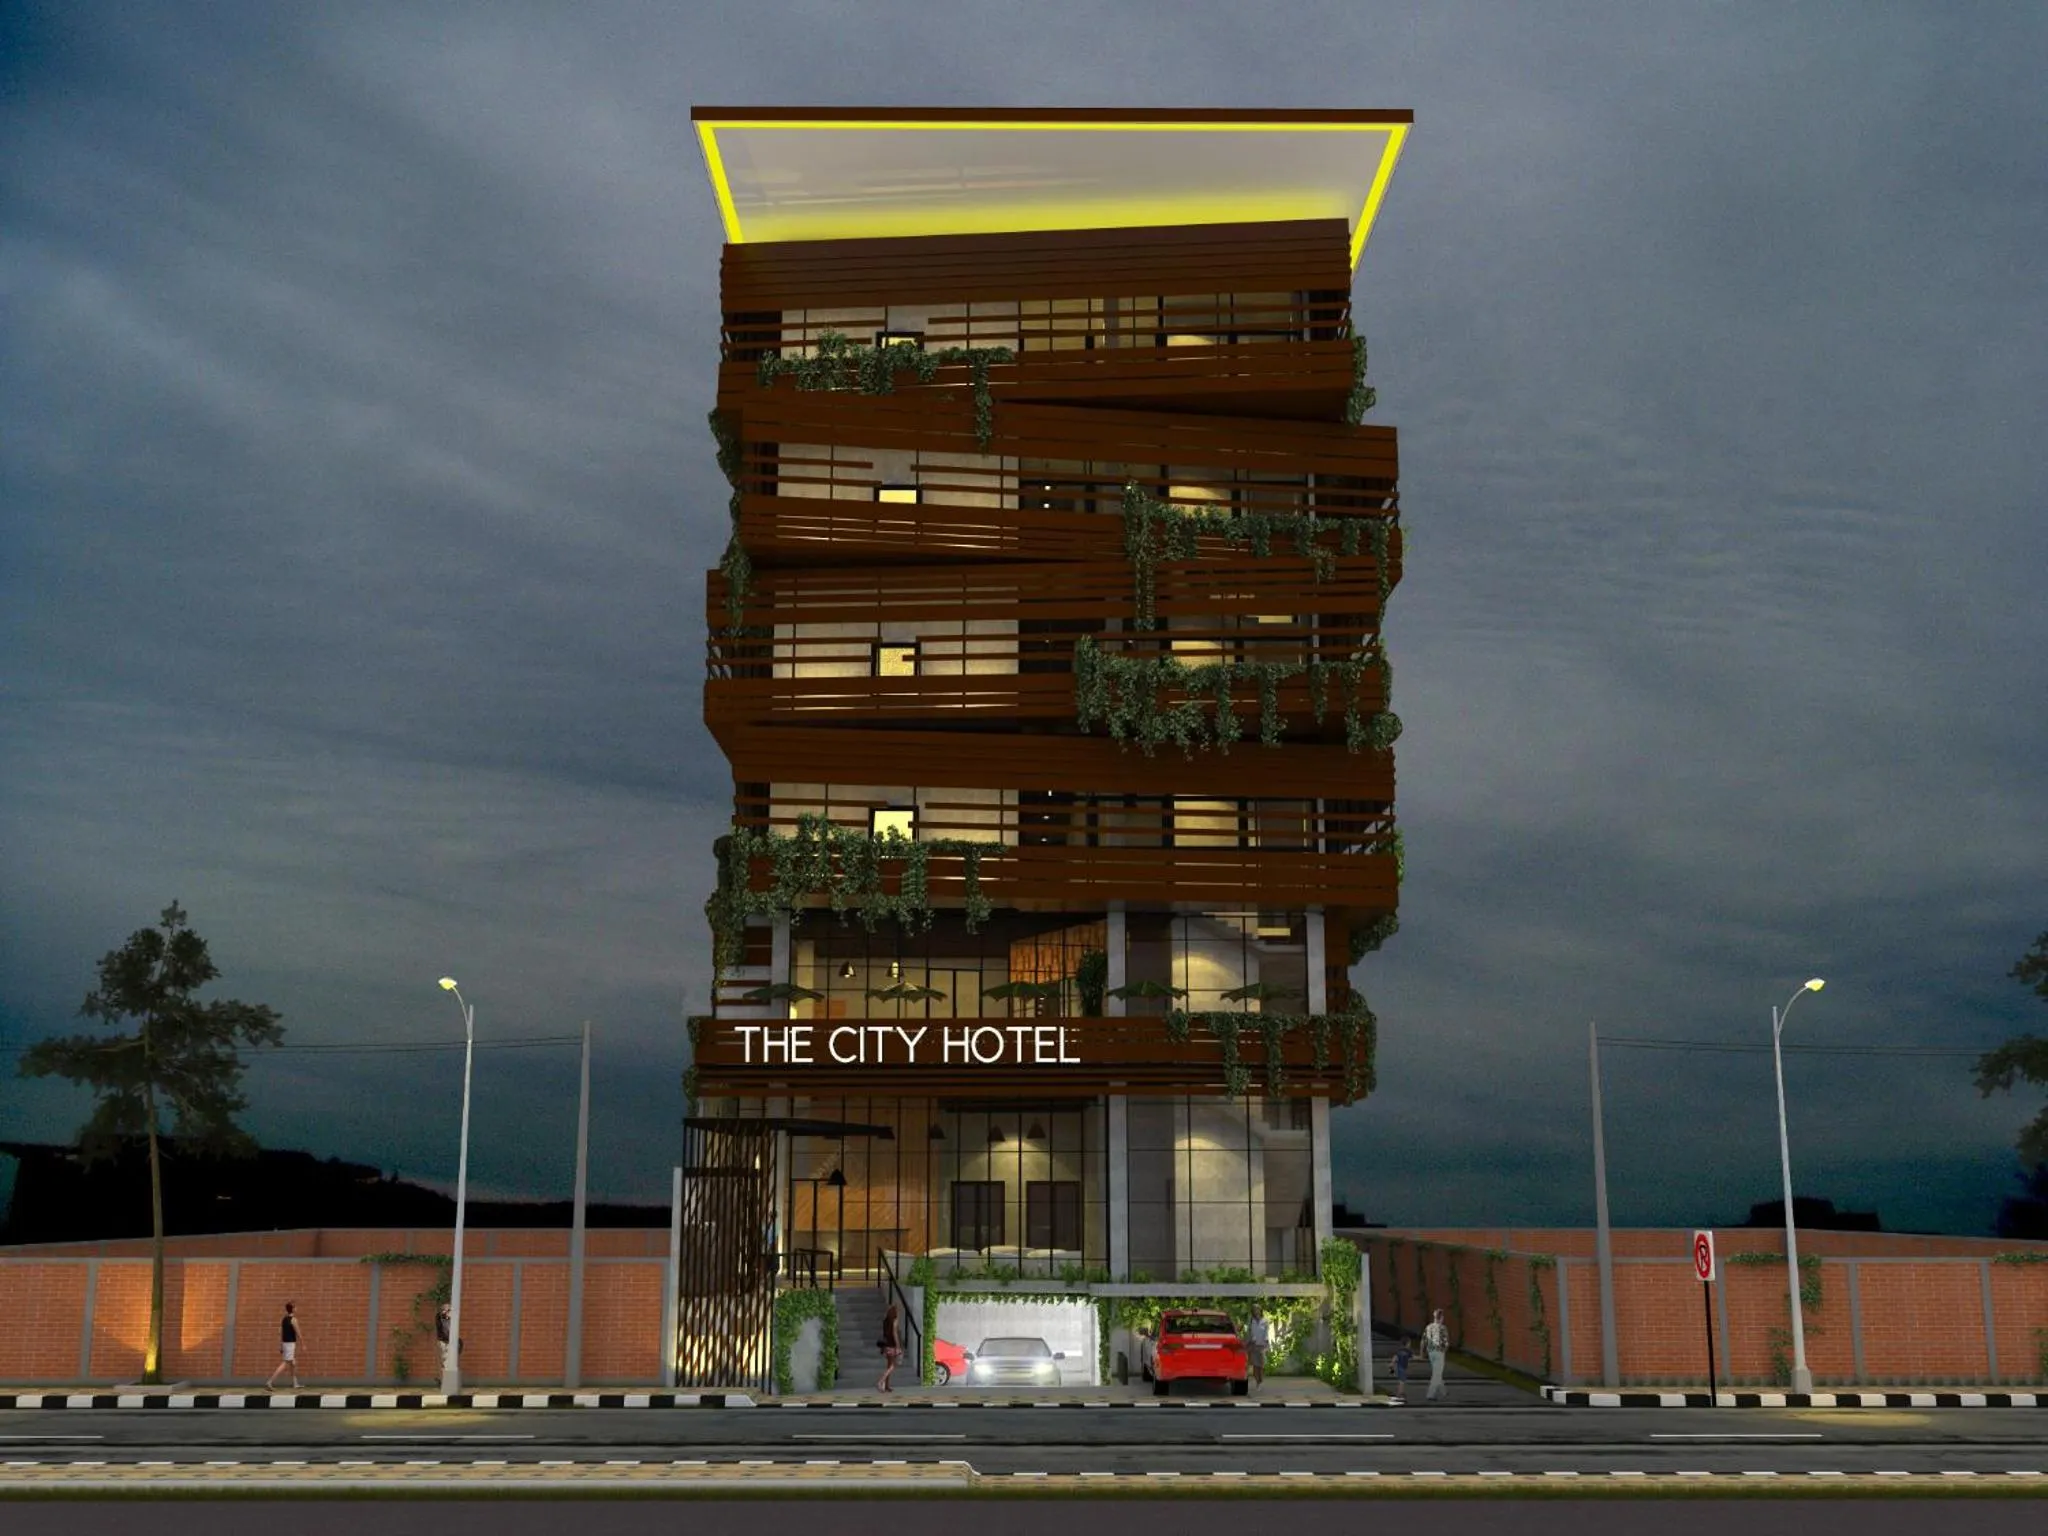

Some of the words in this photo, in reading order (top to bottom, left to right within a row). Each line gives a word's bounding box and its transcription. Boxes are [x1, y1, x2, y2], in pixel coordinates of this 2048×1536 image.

[734, 1026, 814, 1063] THE
[828, 1026, 928, 1063] CITY
[943, 1026, 1081, 1063] HOTEL
